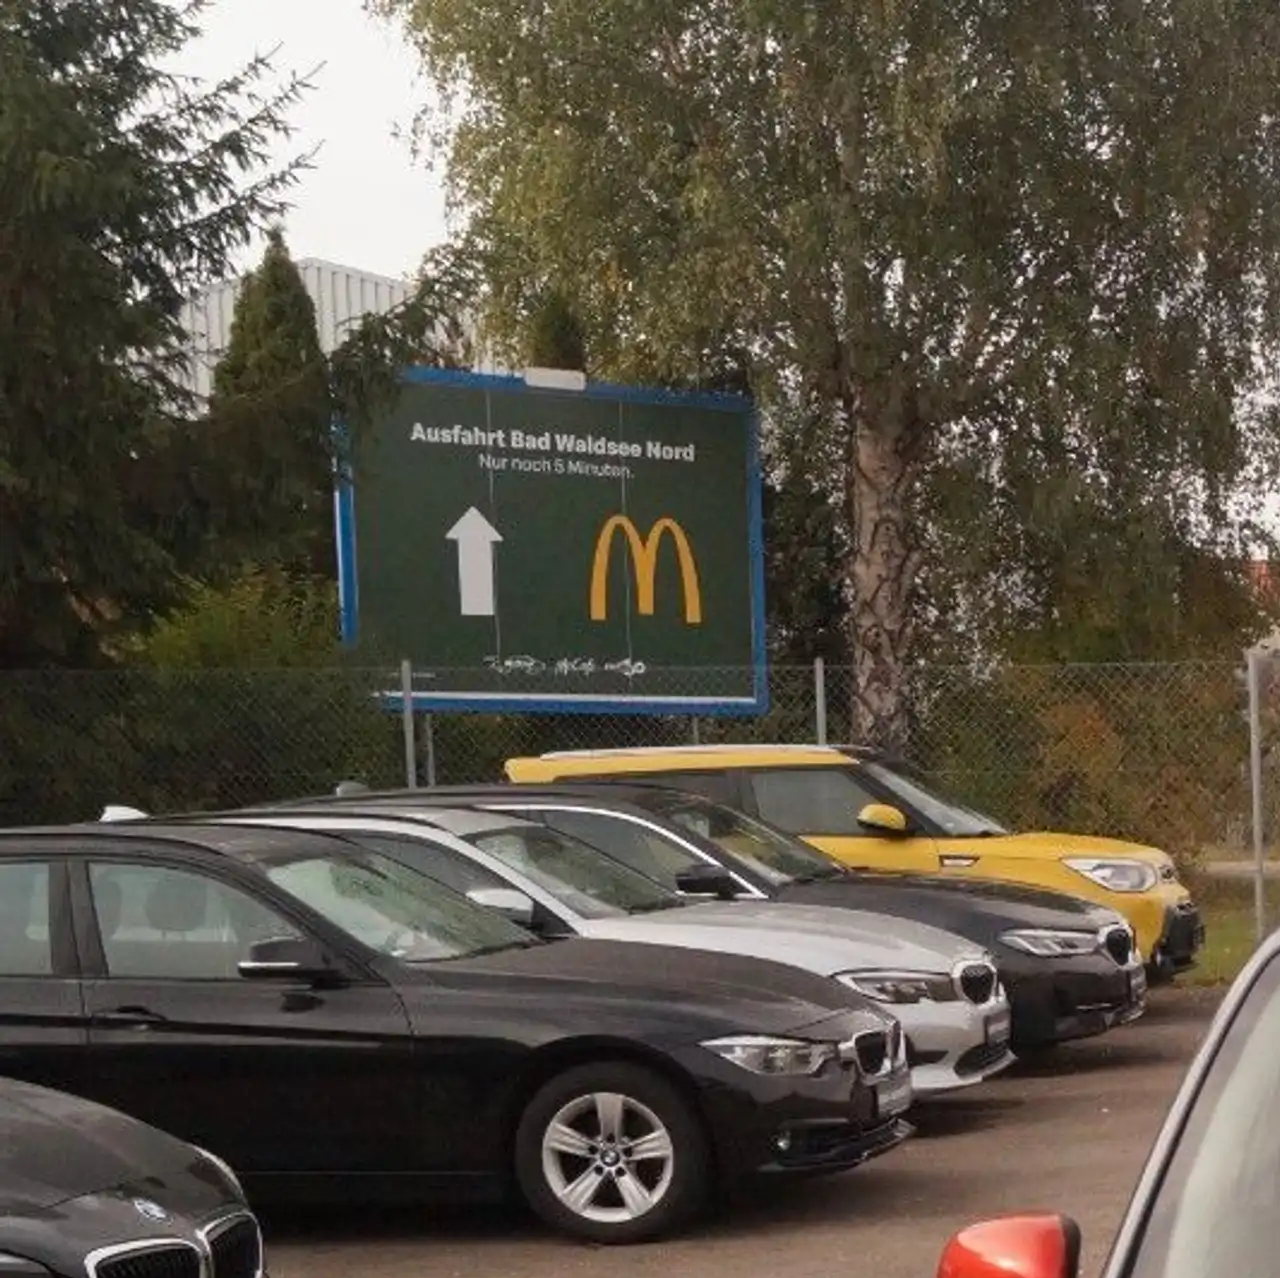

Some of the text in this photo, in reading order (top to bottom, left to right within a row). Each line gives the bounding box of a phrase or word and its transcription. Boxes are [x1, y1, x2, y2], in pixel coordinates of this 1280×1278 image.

[410, 422, 695, 462] Ausfahrt Bad Waldsee Nord
[478, 452, 508, 470] Nur
[511, 456, 550, 472] noch
[554, 458, 565, 474] 5
